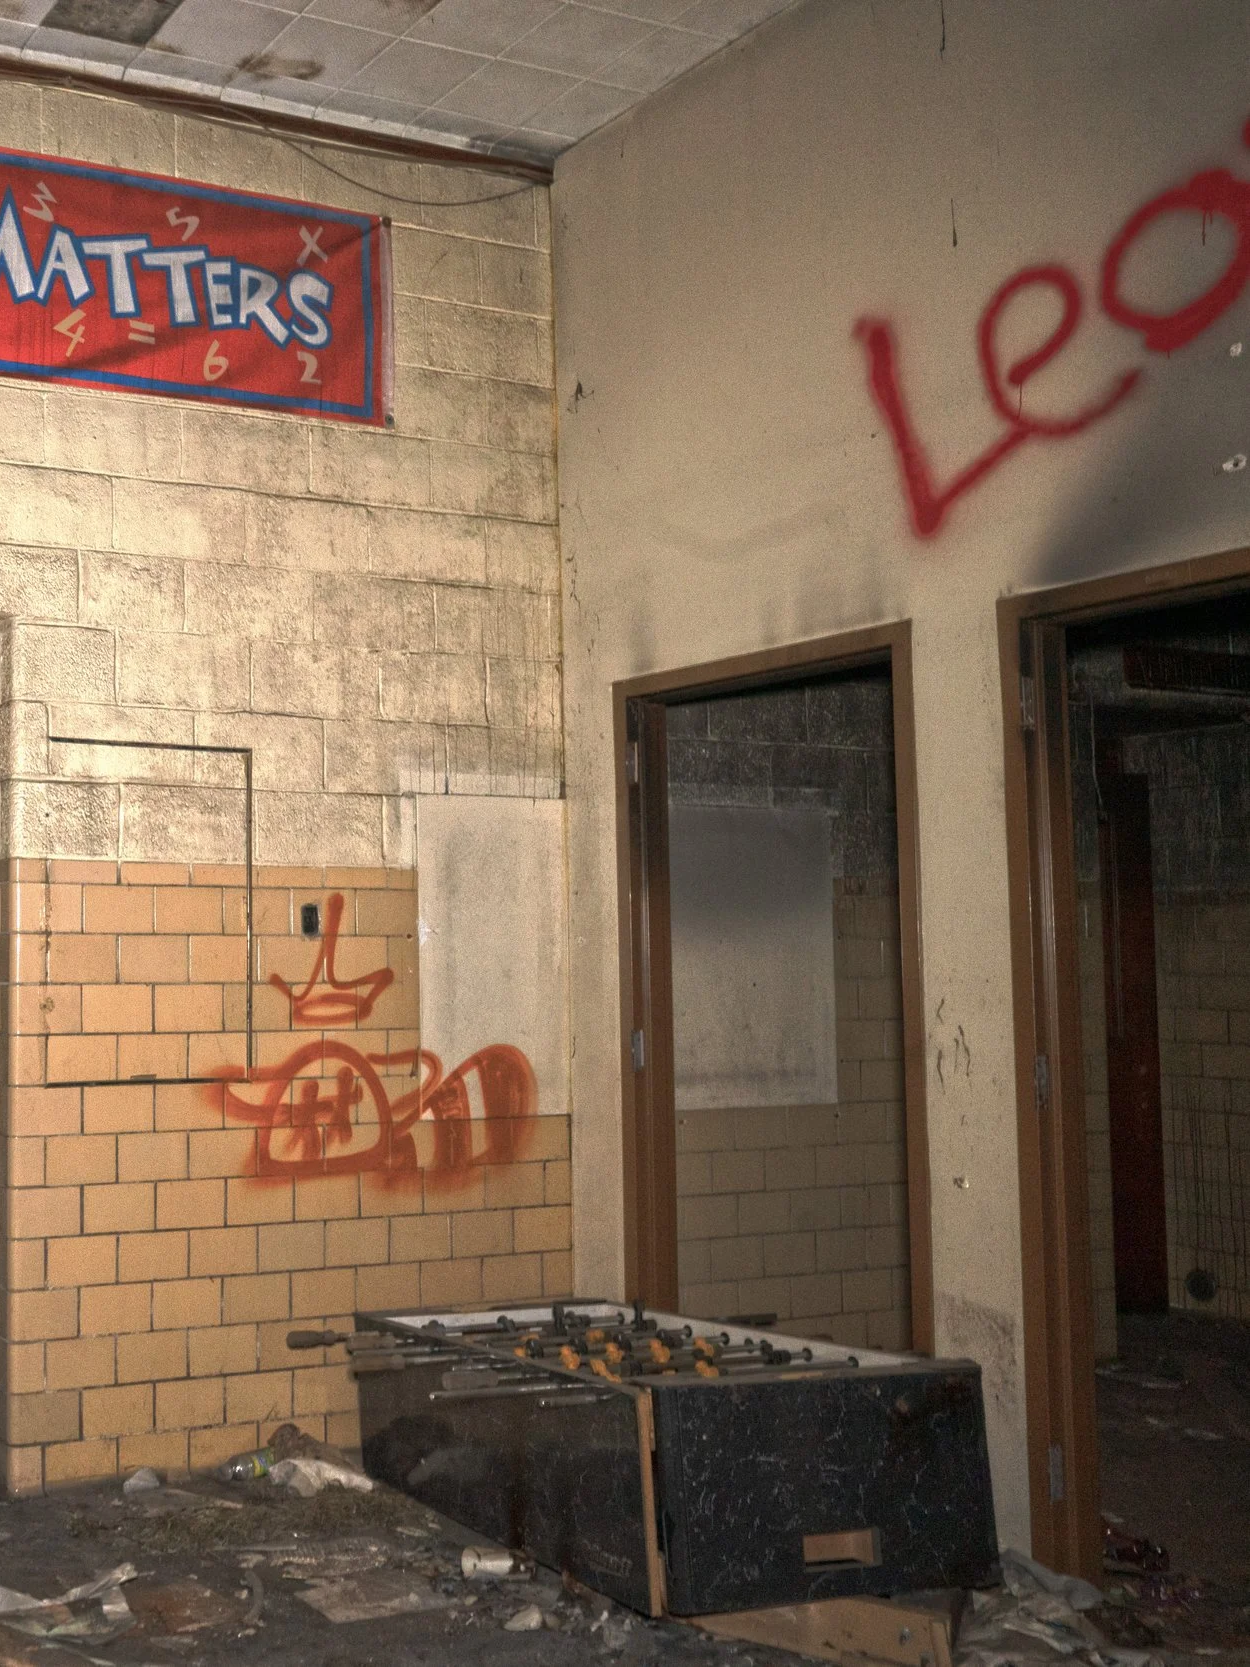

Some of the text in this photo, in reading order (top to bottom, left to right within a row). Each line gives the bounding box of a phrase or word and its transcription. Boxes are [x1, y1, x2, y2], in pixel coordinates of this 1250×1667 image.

[166, 206, 200, 241] 5
[53, 309, 86, 357] 4
[203, 340, 229, 381] 6
[297, 351, 322, 384] 2
